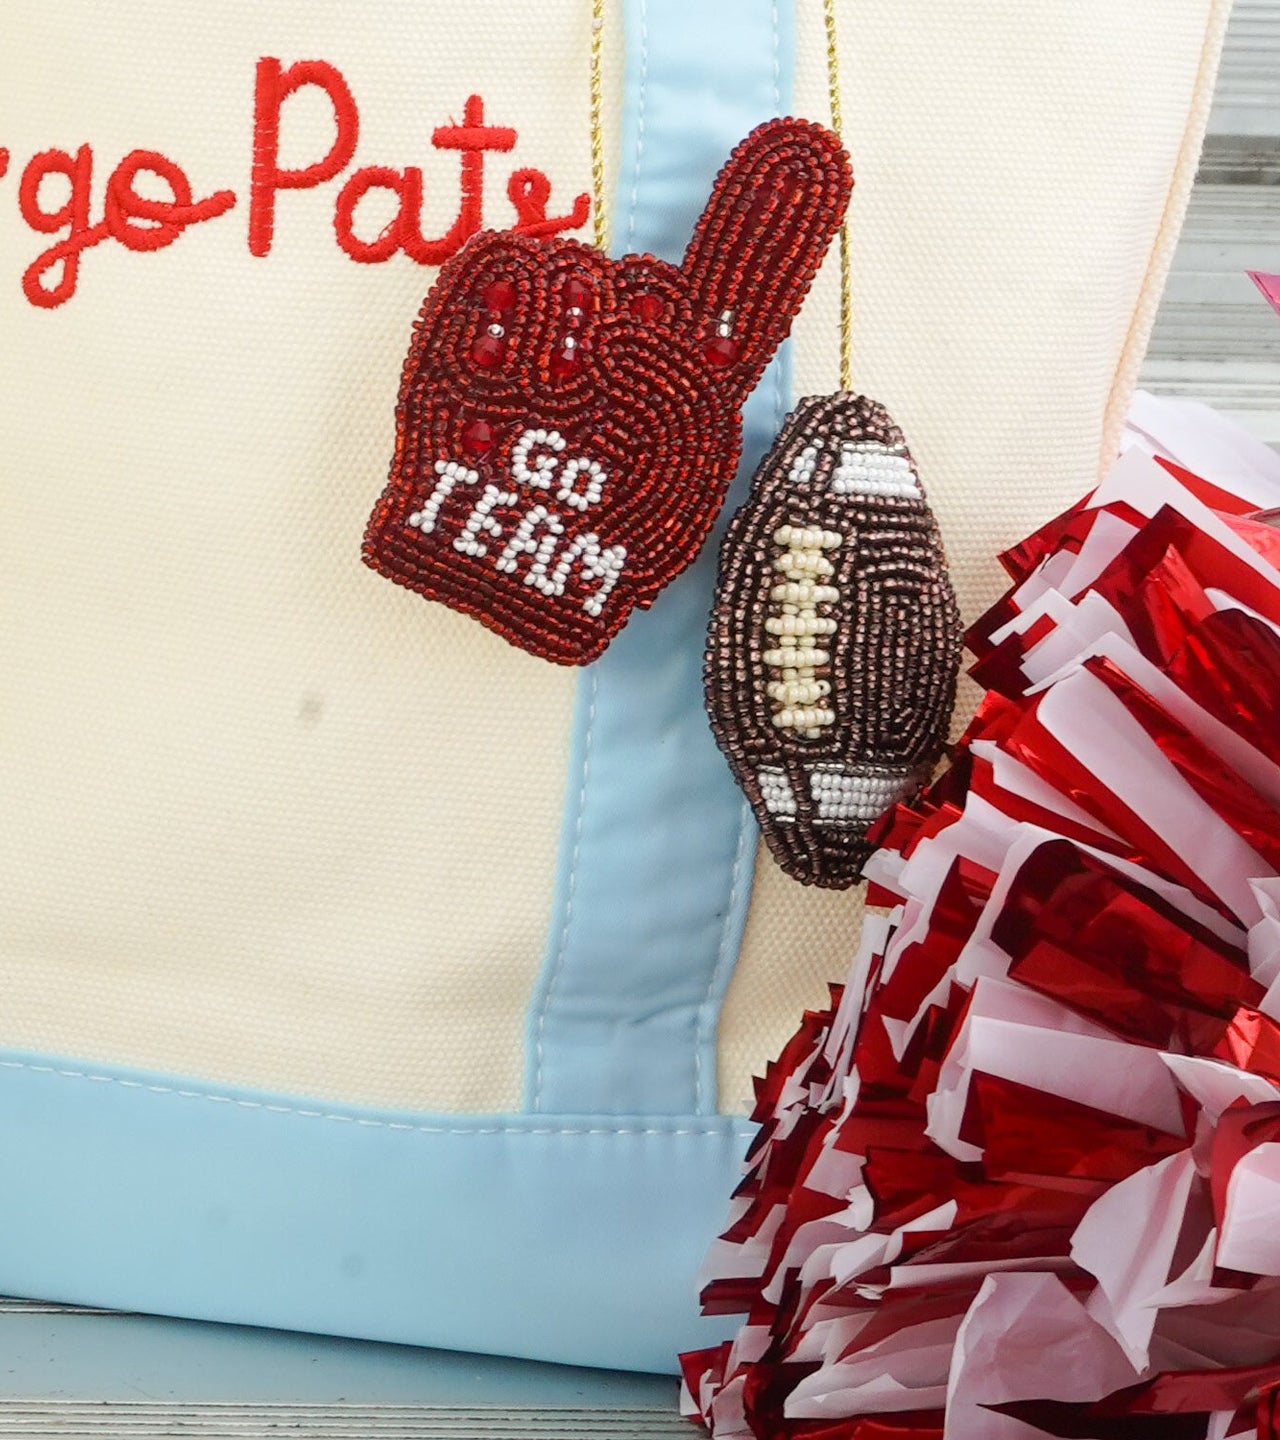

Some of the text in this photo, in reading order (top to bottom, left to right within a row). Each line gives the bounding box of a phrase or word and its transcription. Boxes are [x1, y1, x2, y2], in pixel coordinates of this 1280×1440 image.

[18, 140, 237, 310] go
[247, 55, 592, 265] Pats
[408, 459, 628, 618] TEAM
[511, 428, 608, 512] GO
